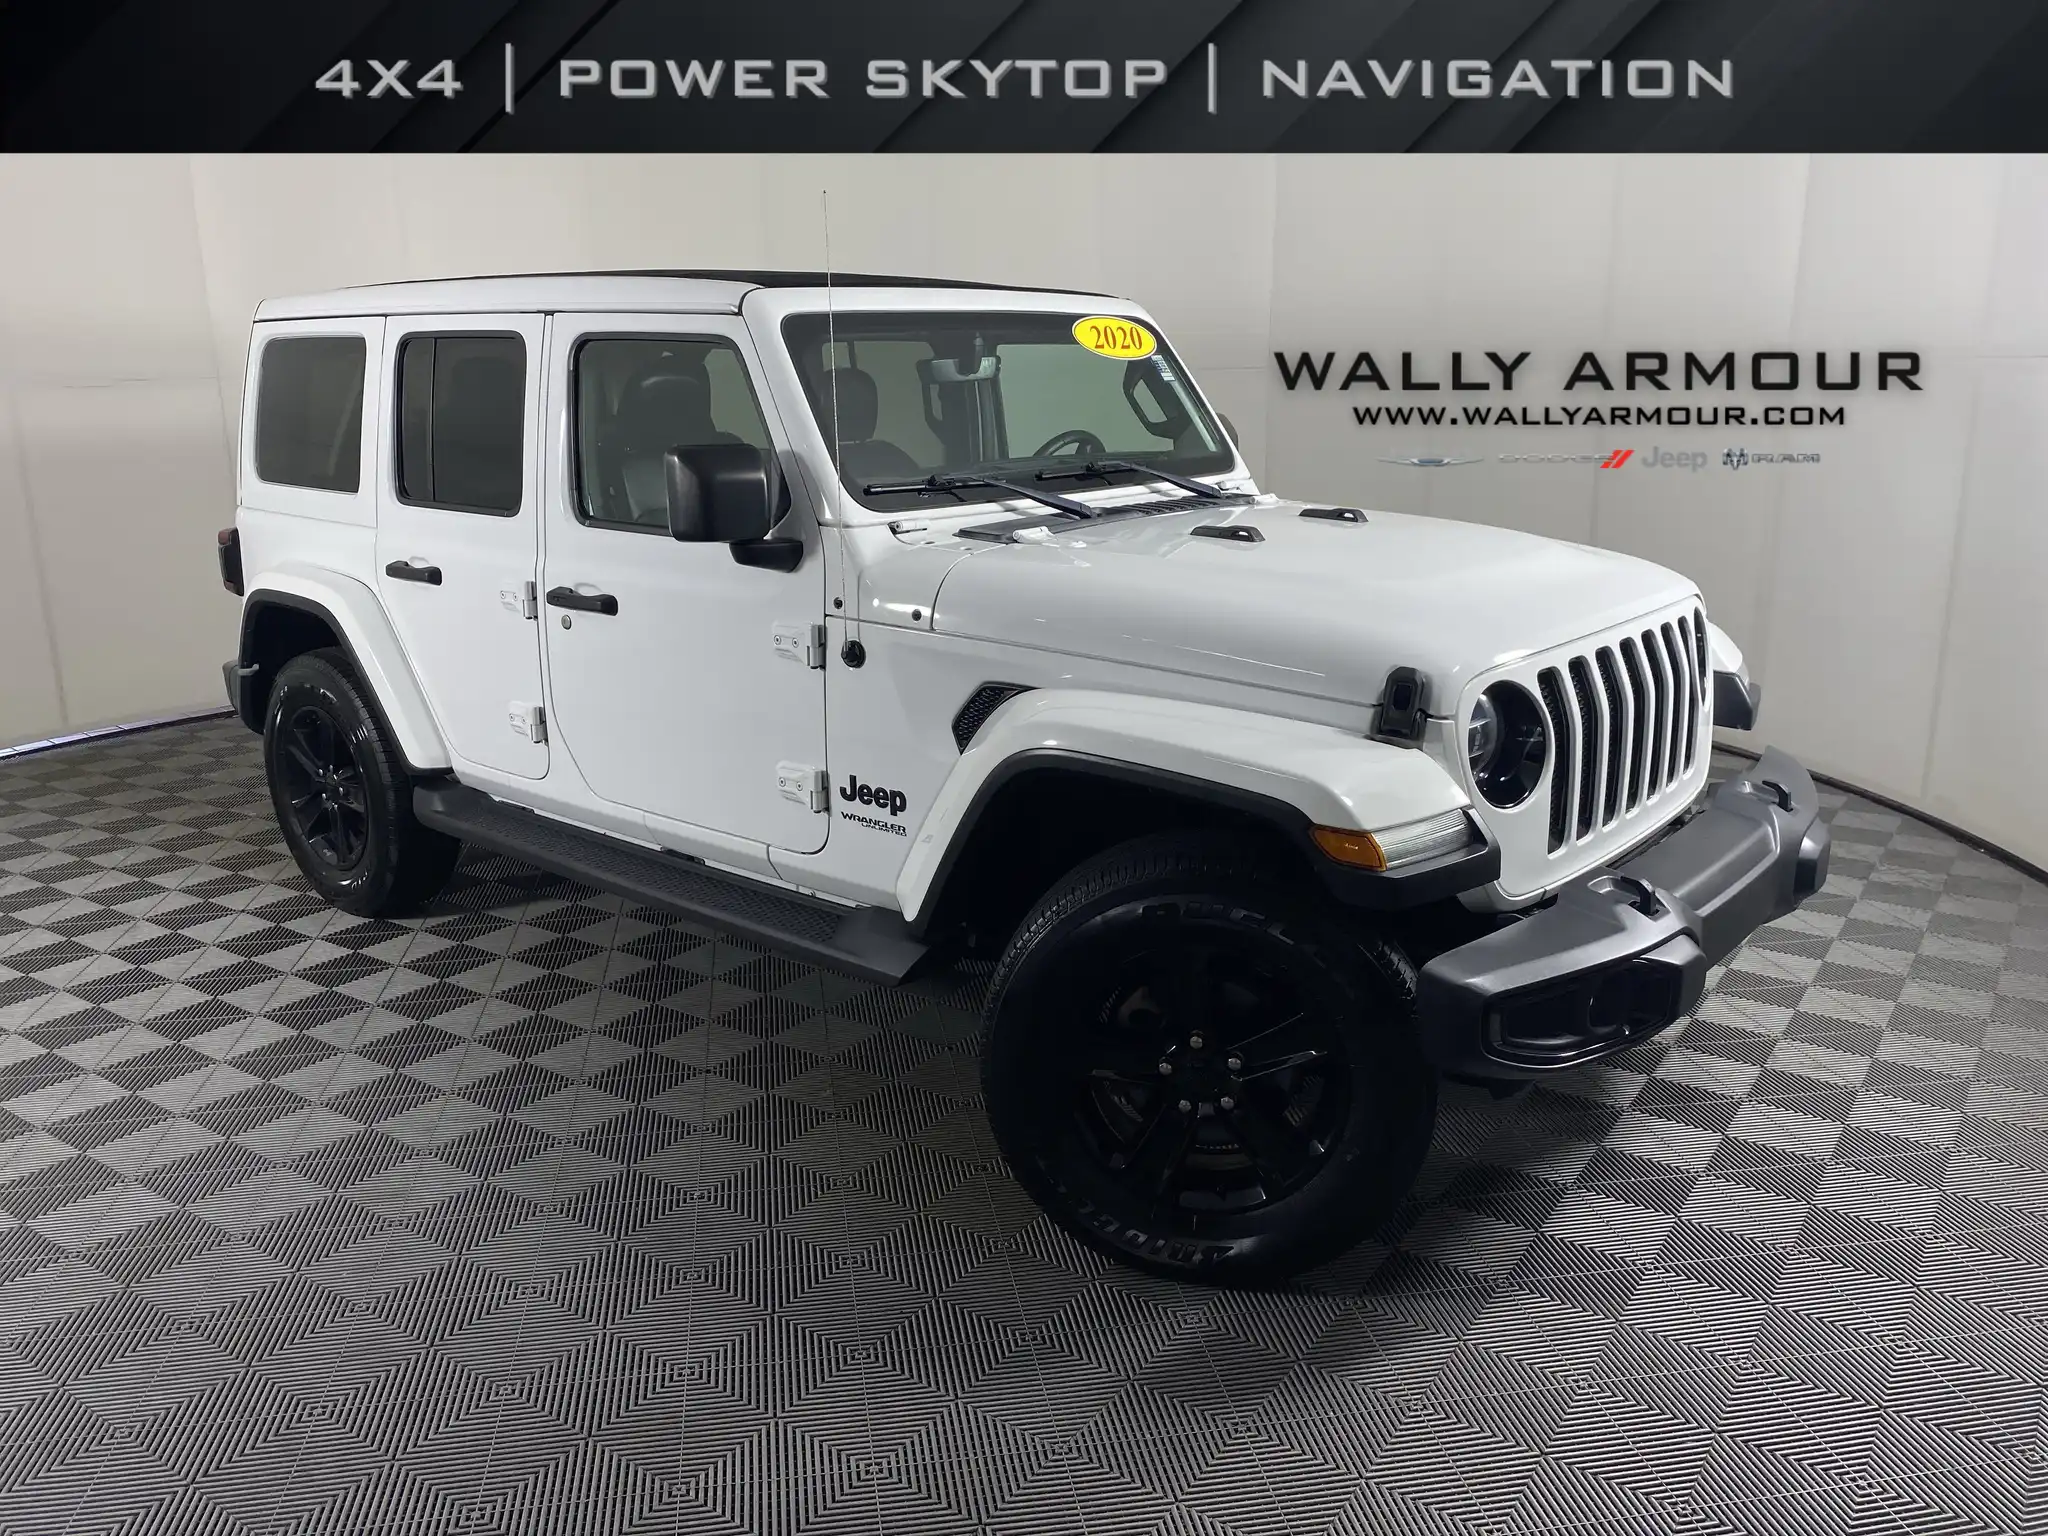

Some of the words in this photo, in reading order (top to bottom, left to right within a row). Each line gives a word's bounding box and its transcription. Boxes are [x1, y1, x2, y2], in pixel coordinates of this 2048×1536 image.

[1090, 325, 1143, 350] 2020
[1273, 351, 1532, 391] WALLY
[1563, 351, 1924, 391] ARMOUR
[1352, 406, 1846, 426] WWW.WALLYARMOUR.COM
[1641, 446, 1708, 470] Jeep
[1751, 453, 1820, 465] RAM
[839, 774, 907, 817] Jeep
[841, 811, 907, 834] WRANGLER
